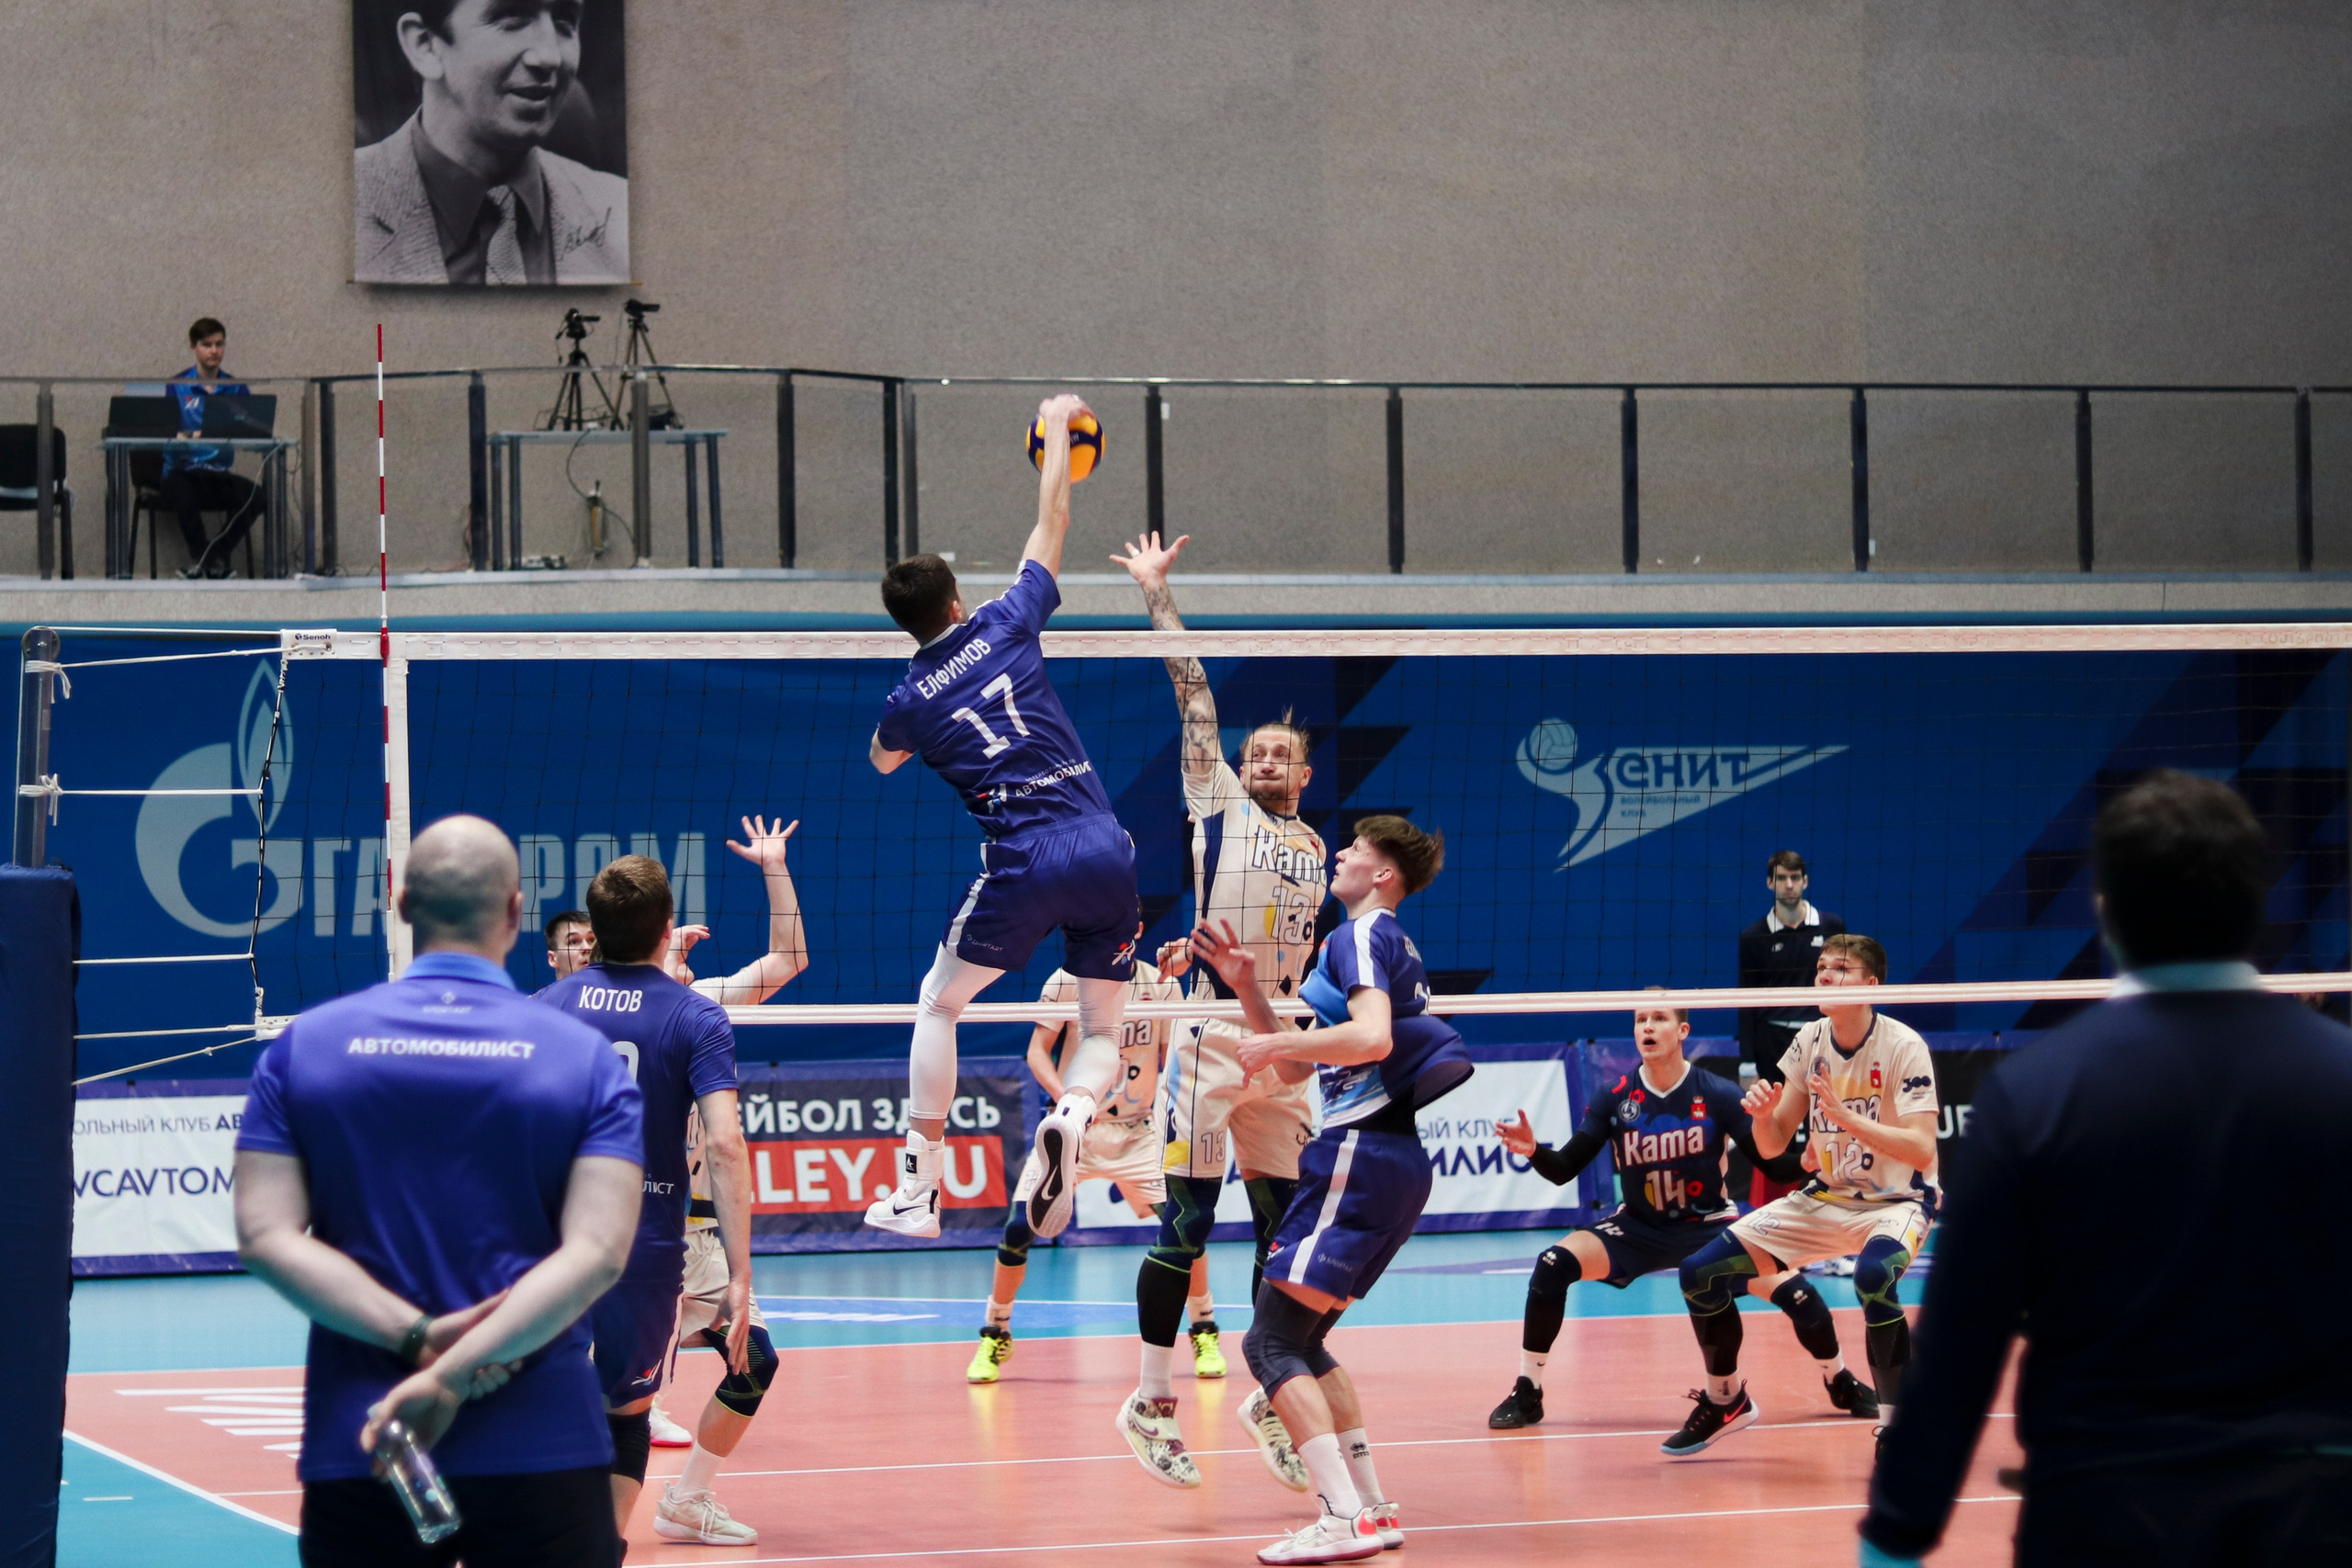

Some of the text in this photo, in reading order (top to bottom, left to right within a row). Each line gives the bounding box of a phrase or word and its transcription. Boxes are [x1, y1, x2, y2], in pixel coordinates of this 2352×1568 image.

[916, 637, 991, 700] ЕЛФИМОВ
[951, 672, 1031, 760] 17
[1271, 886, 1312, 946] 13
[579, 986, 643, 1012] КОТОВ
[347, 1038, 535, 1058] АВТОМОБИЛИСТ
[160, 1116, 211, 1134] КЛУБ
[872, 1096, 1001, 1135] ЗДСЬ
[1623, 1125, 1704, 1167] Kama
[1825, 1142, 1866, 1182] 12
[1645, 1170, 1686, 1212] 14
